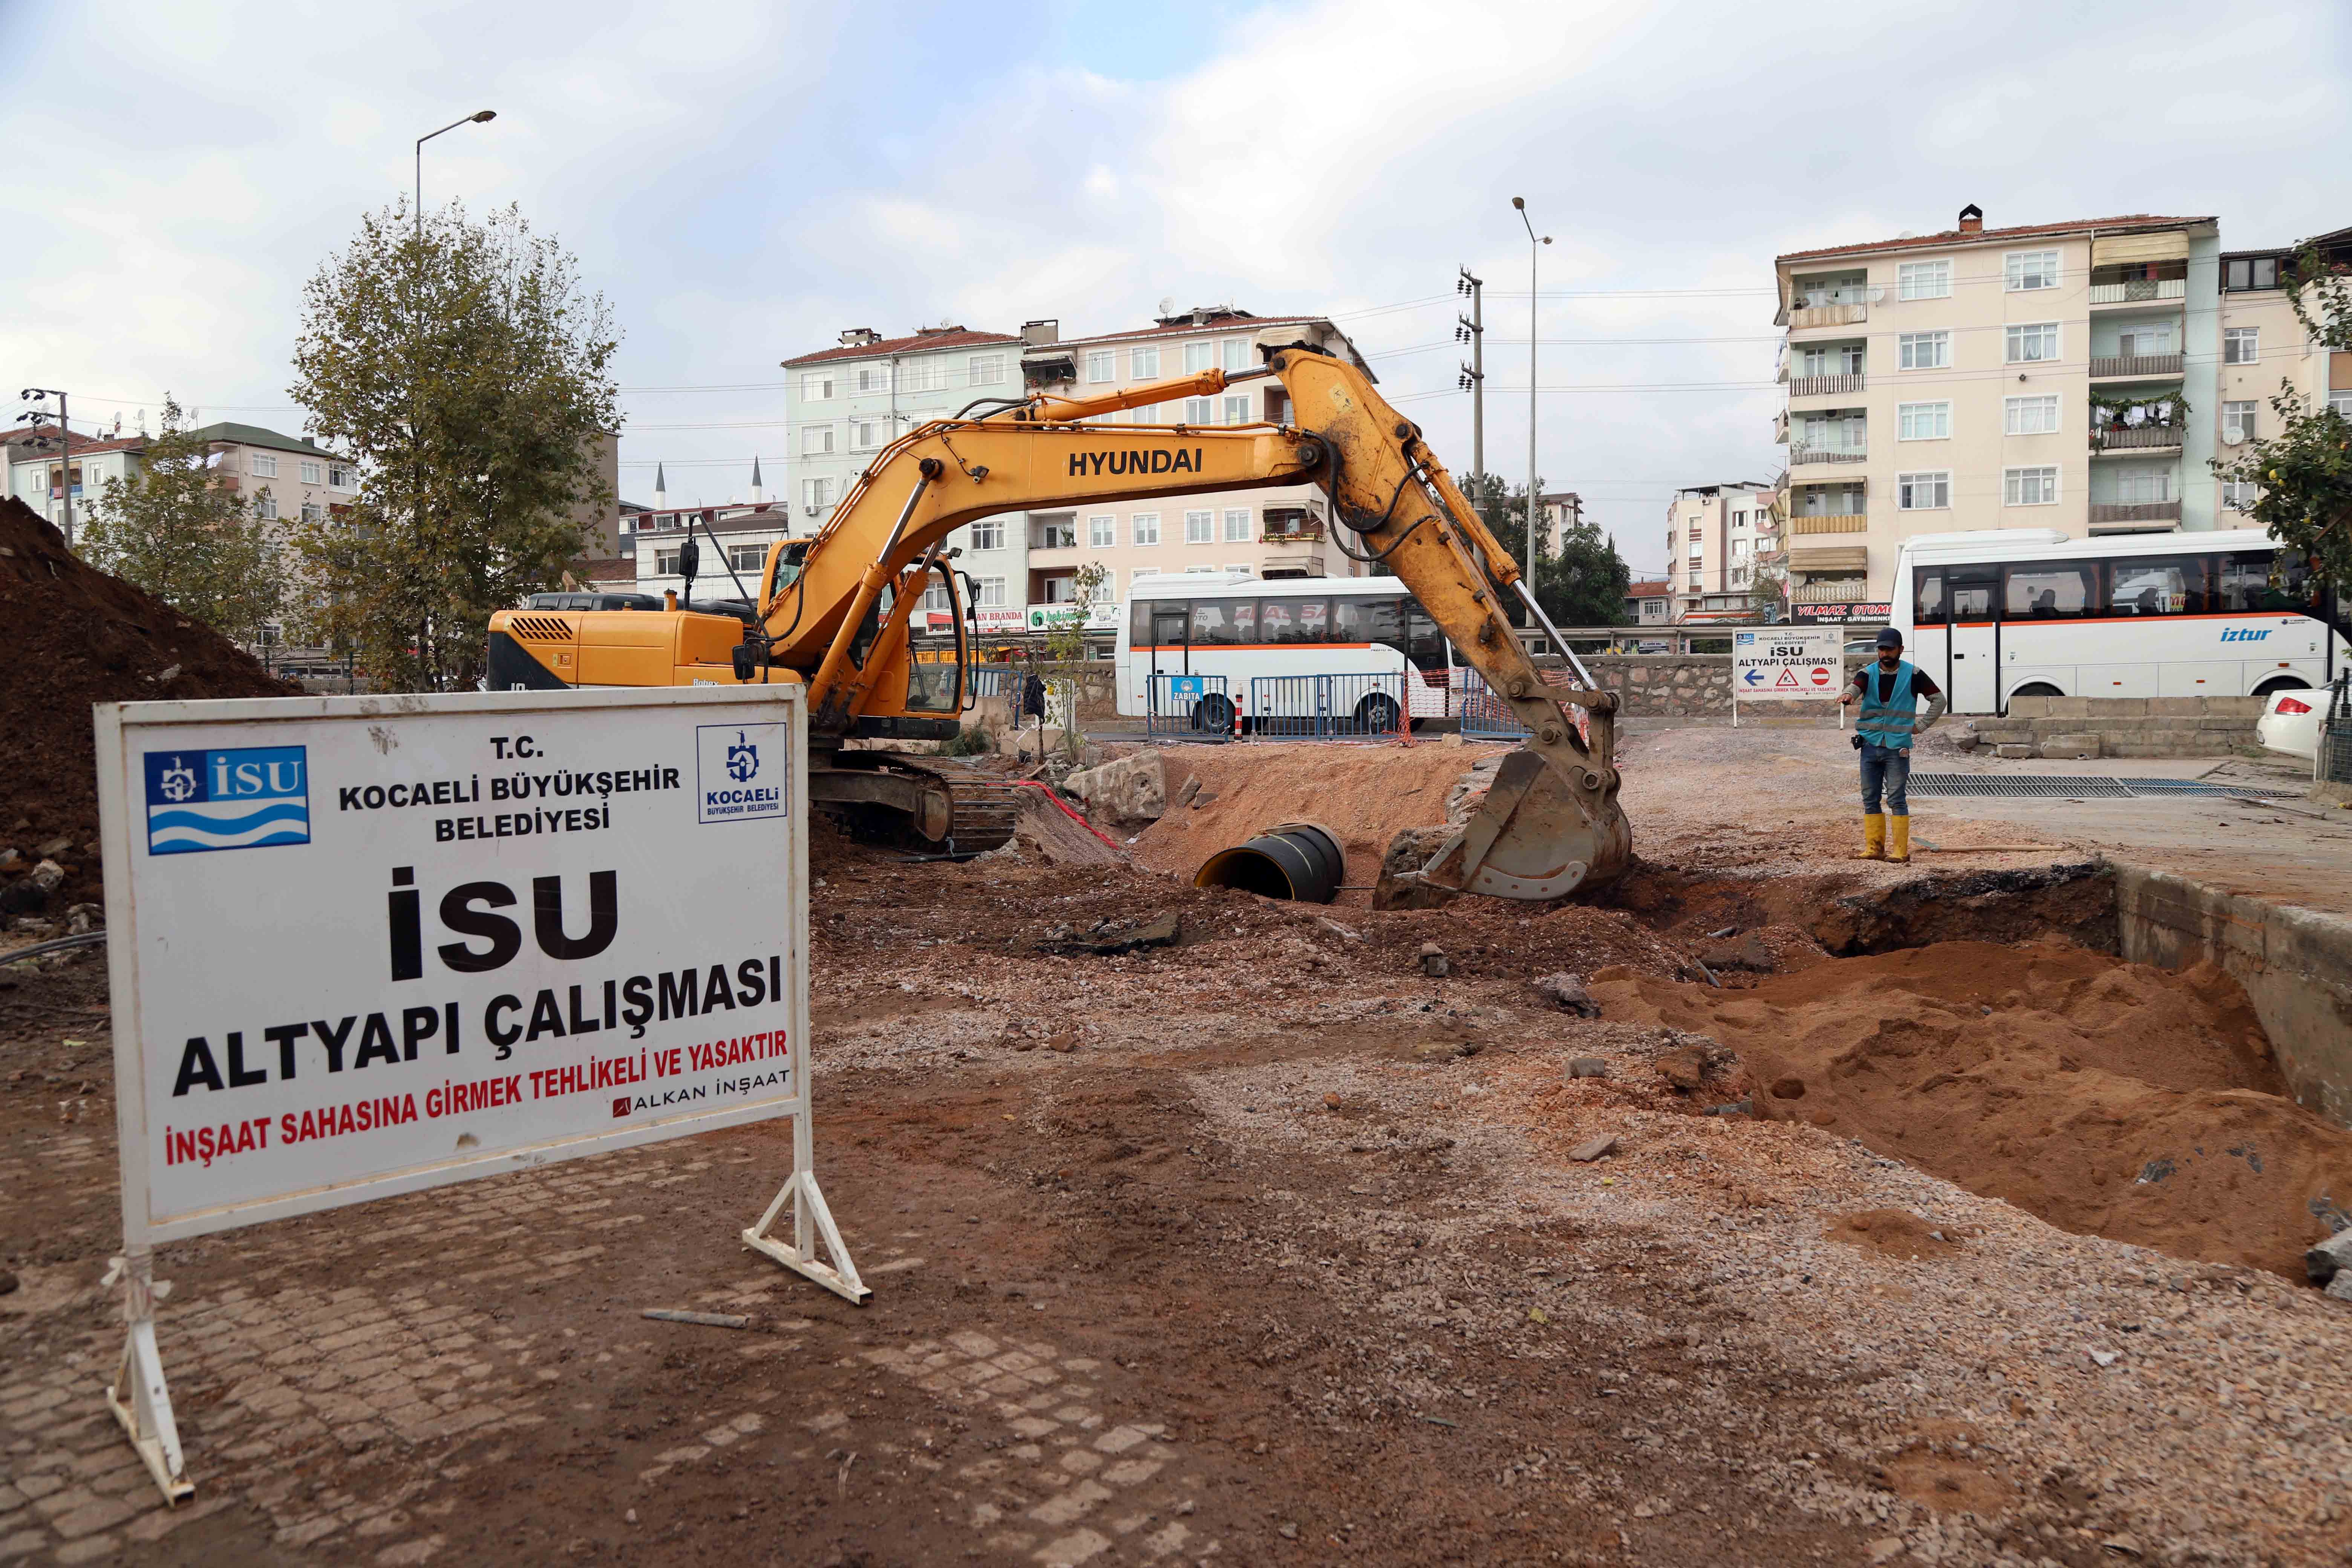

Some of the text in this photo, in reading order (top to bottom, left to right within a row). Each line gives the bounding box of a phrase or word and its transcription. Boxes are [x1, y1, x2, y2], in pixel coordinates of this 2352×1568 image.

[1069, 448, 1202, 476] HYUNDAI
[989, 612, 1023, 620] BRANDA
[1798, 605, 1847, 616] YILMAZ
[2220, 627, 2274, 642] iztur
[1739, 657, 1837, 667] ALTYAPI ÇALIŞMASI
[490, 736, 543, 759] T.C.
[212, 756, 302, 796] İSU
[339, 763, 681, 811] KOCAELİ BÜYÜKŞEHİR
[435, 802, 609, 842] BELEDİYESİ
[388, 866, 618, 982] İSU
[172, 955, 781, 1097] ALTYAPI ÇALIŞMASI
[166, 1029, 788, 1168] İNŞAAT SAHASINA GİRMEK TEHLİKELİ VE YASAKTIR
[634, 1069, 790, 1110] ALKAN İNŞAAT
